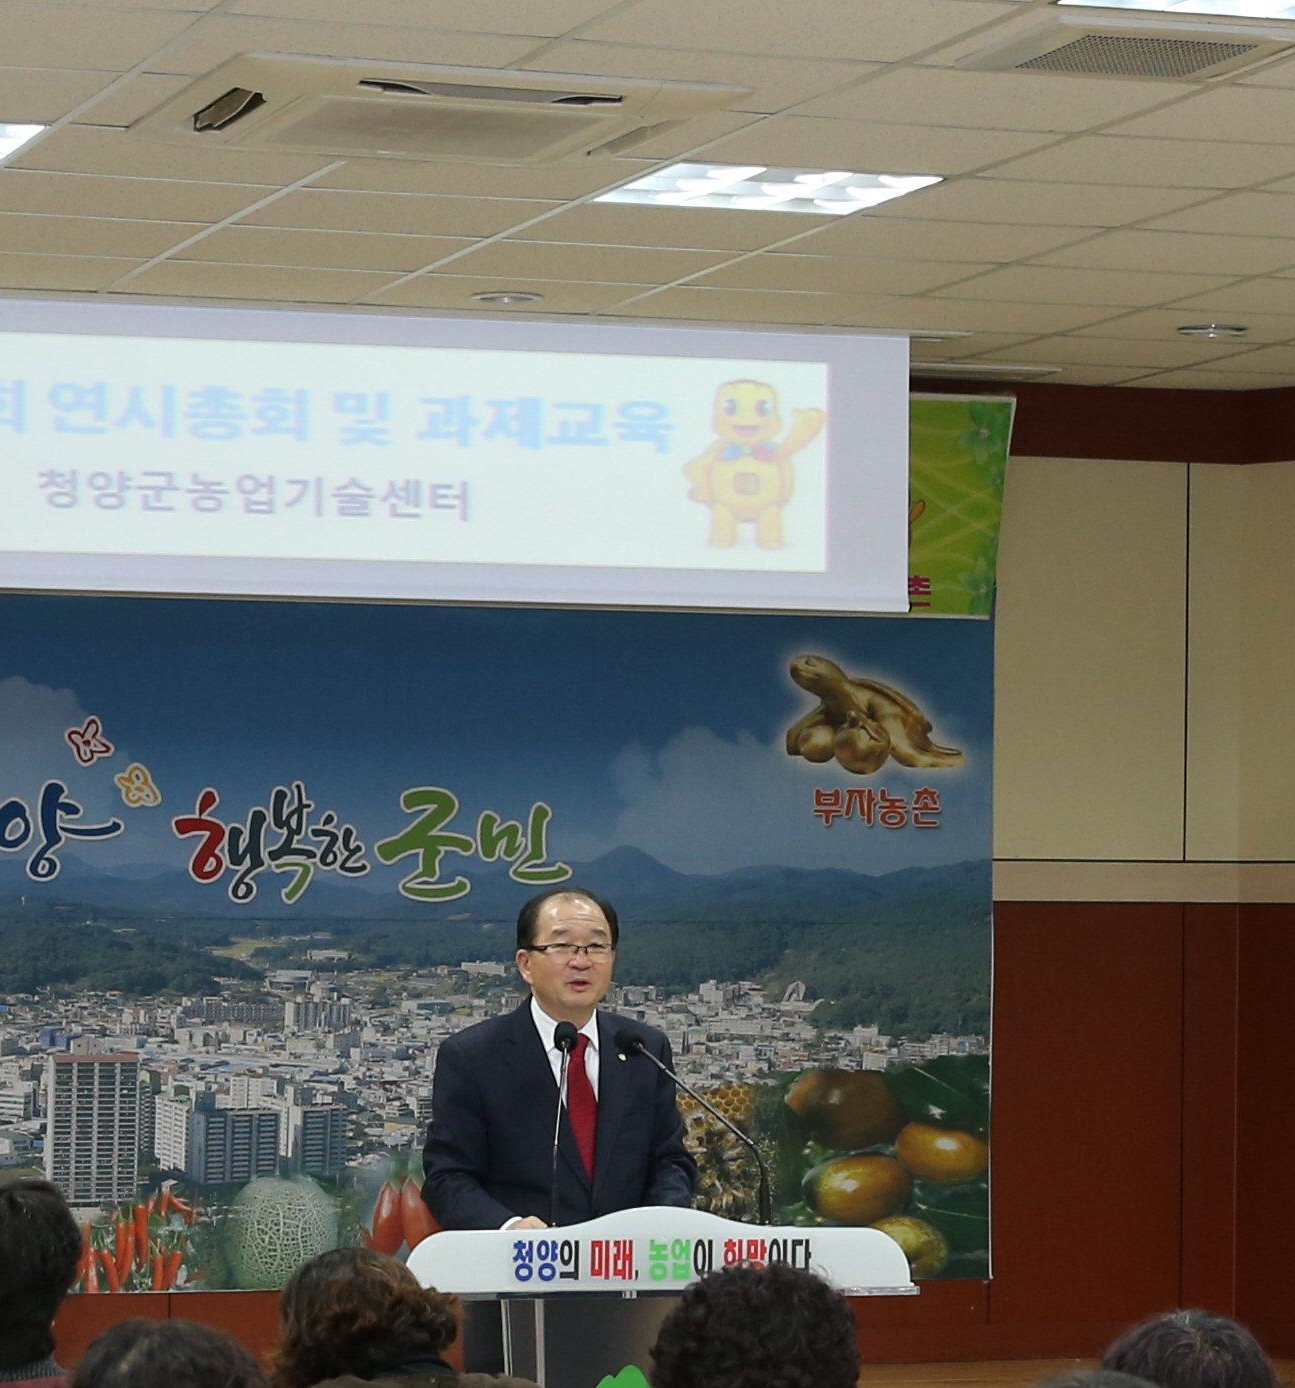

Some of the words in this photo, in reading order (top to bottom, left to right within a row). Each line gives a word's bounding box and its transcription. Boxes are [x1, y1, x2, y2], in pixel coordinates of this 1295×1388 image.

[47, 382, 310, 443] 연시총회
[332, 389, 393, 448] 및
[417, 394, 676, 455] 과제교육
[37, 468, 471, 522] 청양군농업기술센터
[812, 786, 941, 829] 부자농촌
[172, 780, 371, 905] 행복한
[374, 785, 574, 903] 군민
[512, 1238, 581, 1282] 청양의
[589, 1238, 640, 1282] 미래,
[648, 1237, 714, 1281] 농업이
